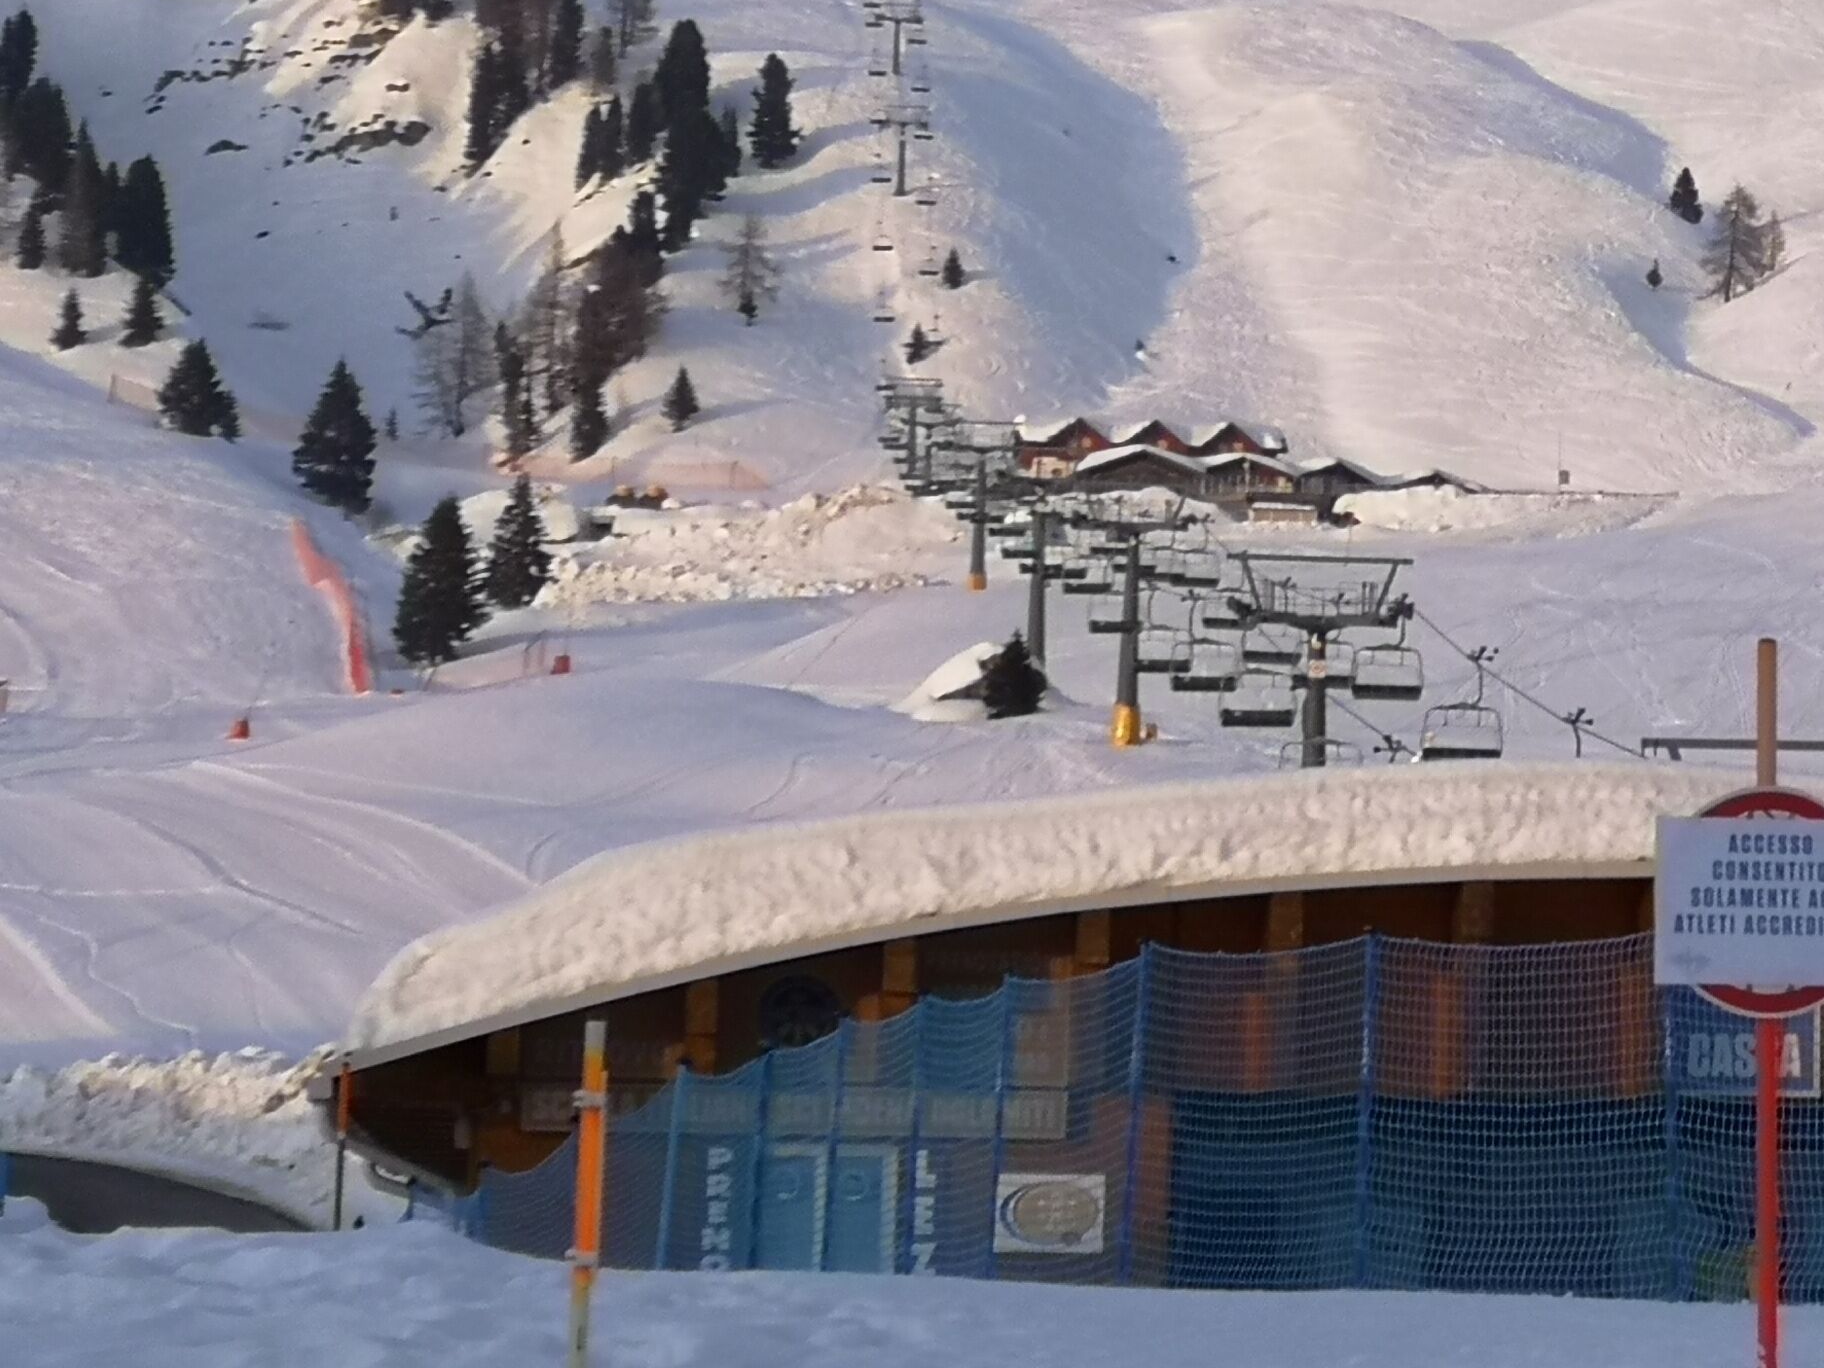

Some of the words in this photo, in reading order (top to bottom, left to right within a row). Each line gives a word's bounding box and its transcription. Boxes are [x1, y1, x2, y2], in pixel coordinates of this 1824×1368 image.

[1728, 833, 1814, 855] ACCESSO
[1690, 886, 1801, 909] SOLAMENTE
[1673, 913, 1736, 934] ATLETI
[1687, 1032, 1801, 1078] CASA
